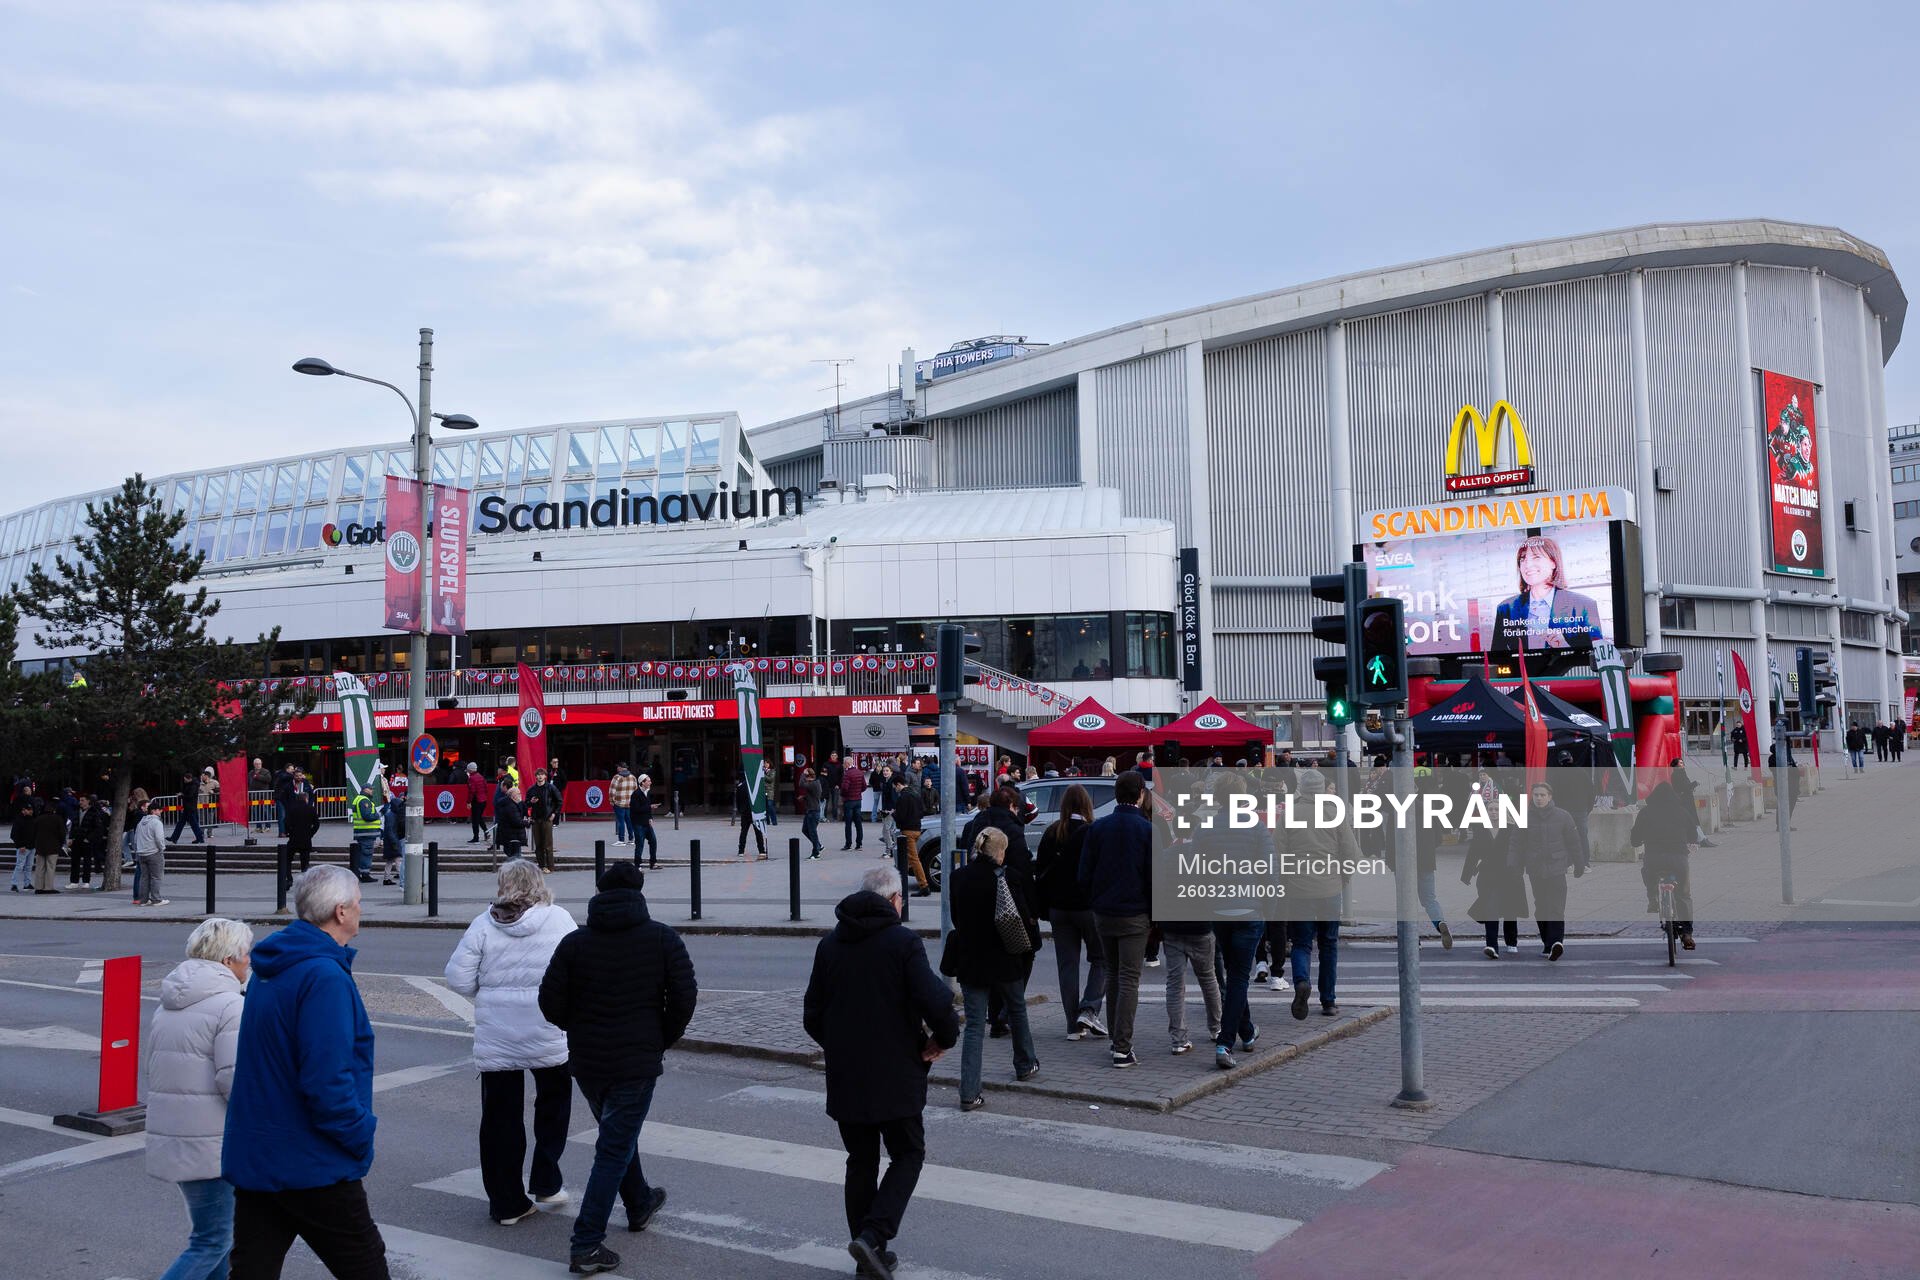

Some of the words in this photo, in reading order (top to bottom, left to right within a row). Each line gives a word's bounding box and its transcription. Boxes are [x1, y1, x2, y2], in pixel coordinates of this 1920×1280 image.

[916, 357, 954, 372] GTHIA
[955, 349, 994, 365] TOWERS
[1459, 475, 1491, 487] ALLTID
[1493, 472, 1525, 484] ÖPPET
[1774, 483, 1799, 506] MATCH
[1800, 488, 1818, 508] IDAG!
[478, 481, 803, 534] Scandinavium
[1372, 491, 1612, 539] SCANDINAVIUM
[439, 505, 460, 596] SLUTSPEL
[1375, 552, 1414, 566] SVEA
[1184, 573, 1195, 603] Glöd
[1375, 581, 1458, 613] Tänk
[395, 611, 410, 620] SHL
[1185, 606, 1196, 630] Kök
[1503, 616, 1536, 627] Banken
[1538, 615, 1551, 625] för
[1564, 615, 1584, 623] som
[1185, 633, 1196, 641] &
[1404, 614, 1461, 643] ort
[1503, 626, 1545, 637] förändrar
[1547, 625, 1594, 636] branscher.
[1186, 644, 1197, 666] Bar
[642, 704, 714, 720] BILJETTER/TICKETS
[852, 697, 902, 714] BORTAENTRÉ
[375, 715, 408, 728] ONGSKORT
[463, 711, 496, 725] VIP/LOGE
